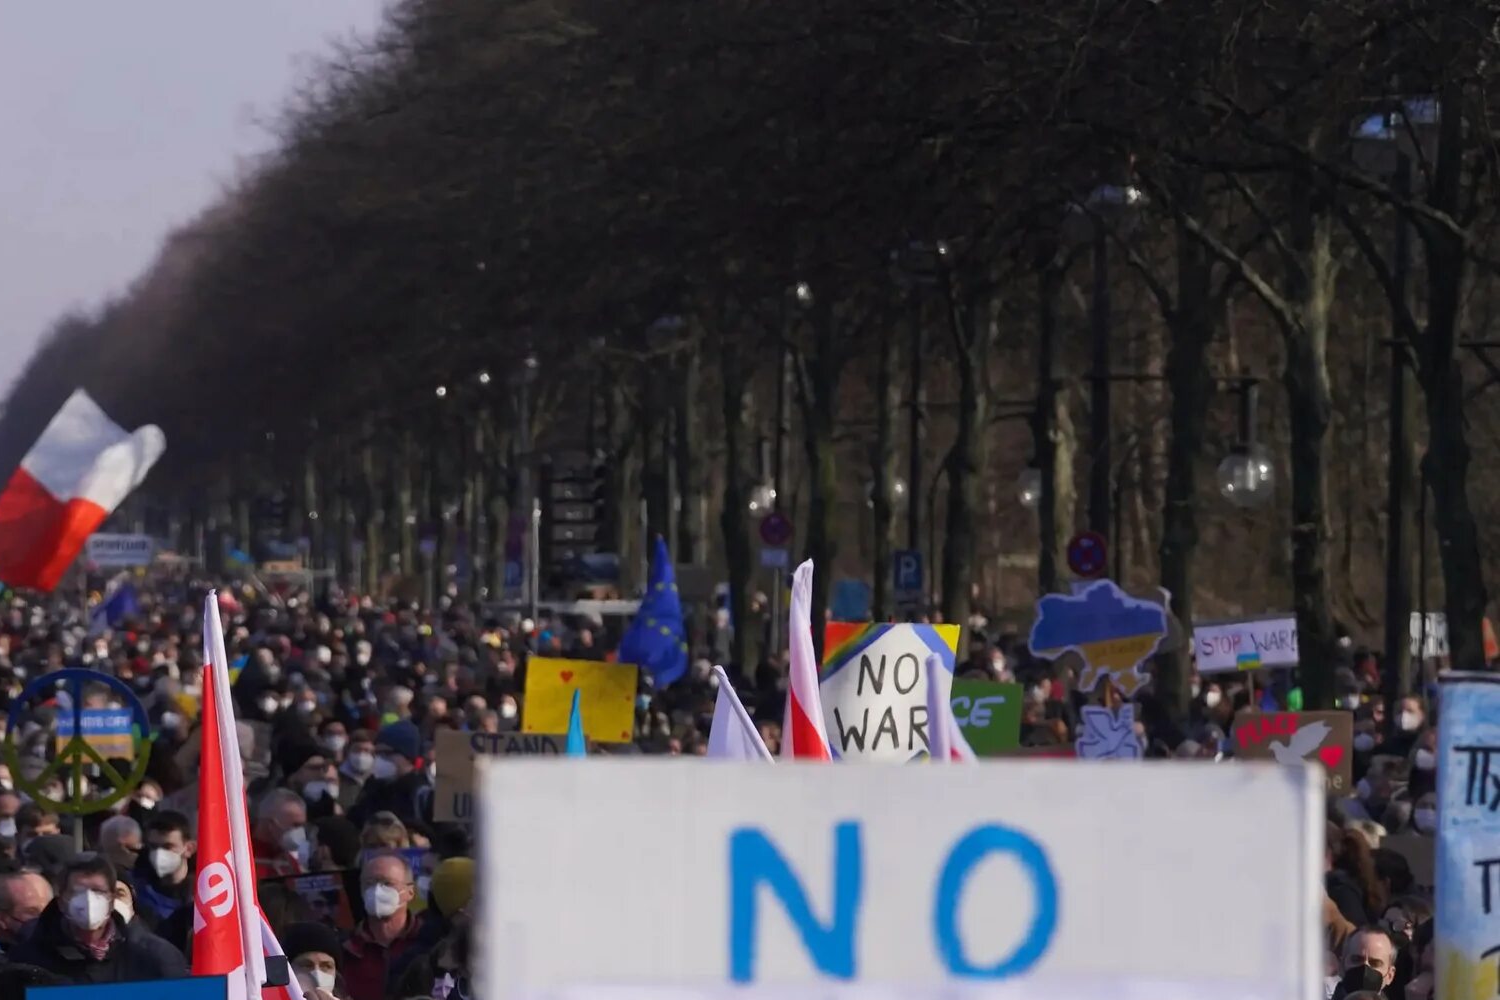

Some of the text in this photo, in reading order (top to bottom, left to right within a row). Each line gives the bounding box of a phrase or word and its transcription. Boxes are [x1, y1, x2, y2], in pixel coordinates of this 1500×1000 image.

[1202, 629, 1297, 656] STOP WAR!
[857, 652, 920, 697] NO
[834, 705, 931, 752] WAR
[727, 819, 1061, 984] NO
